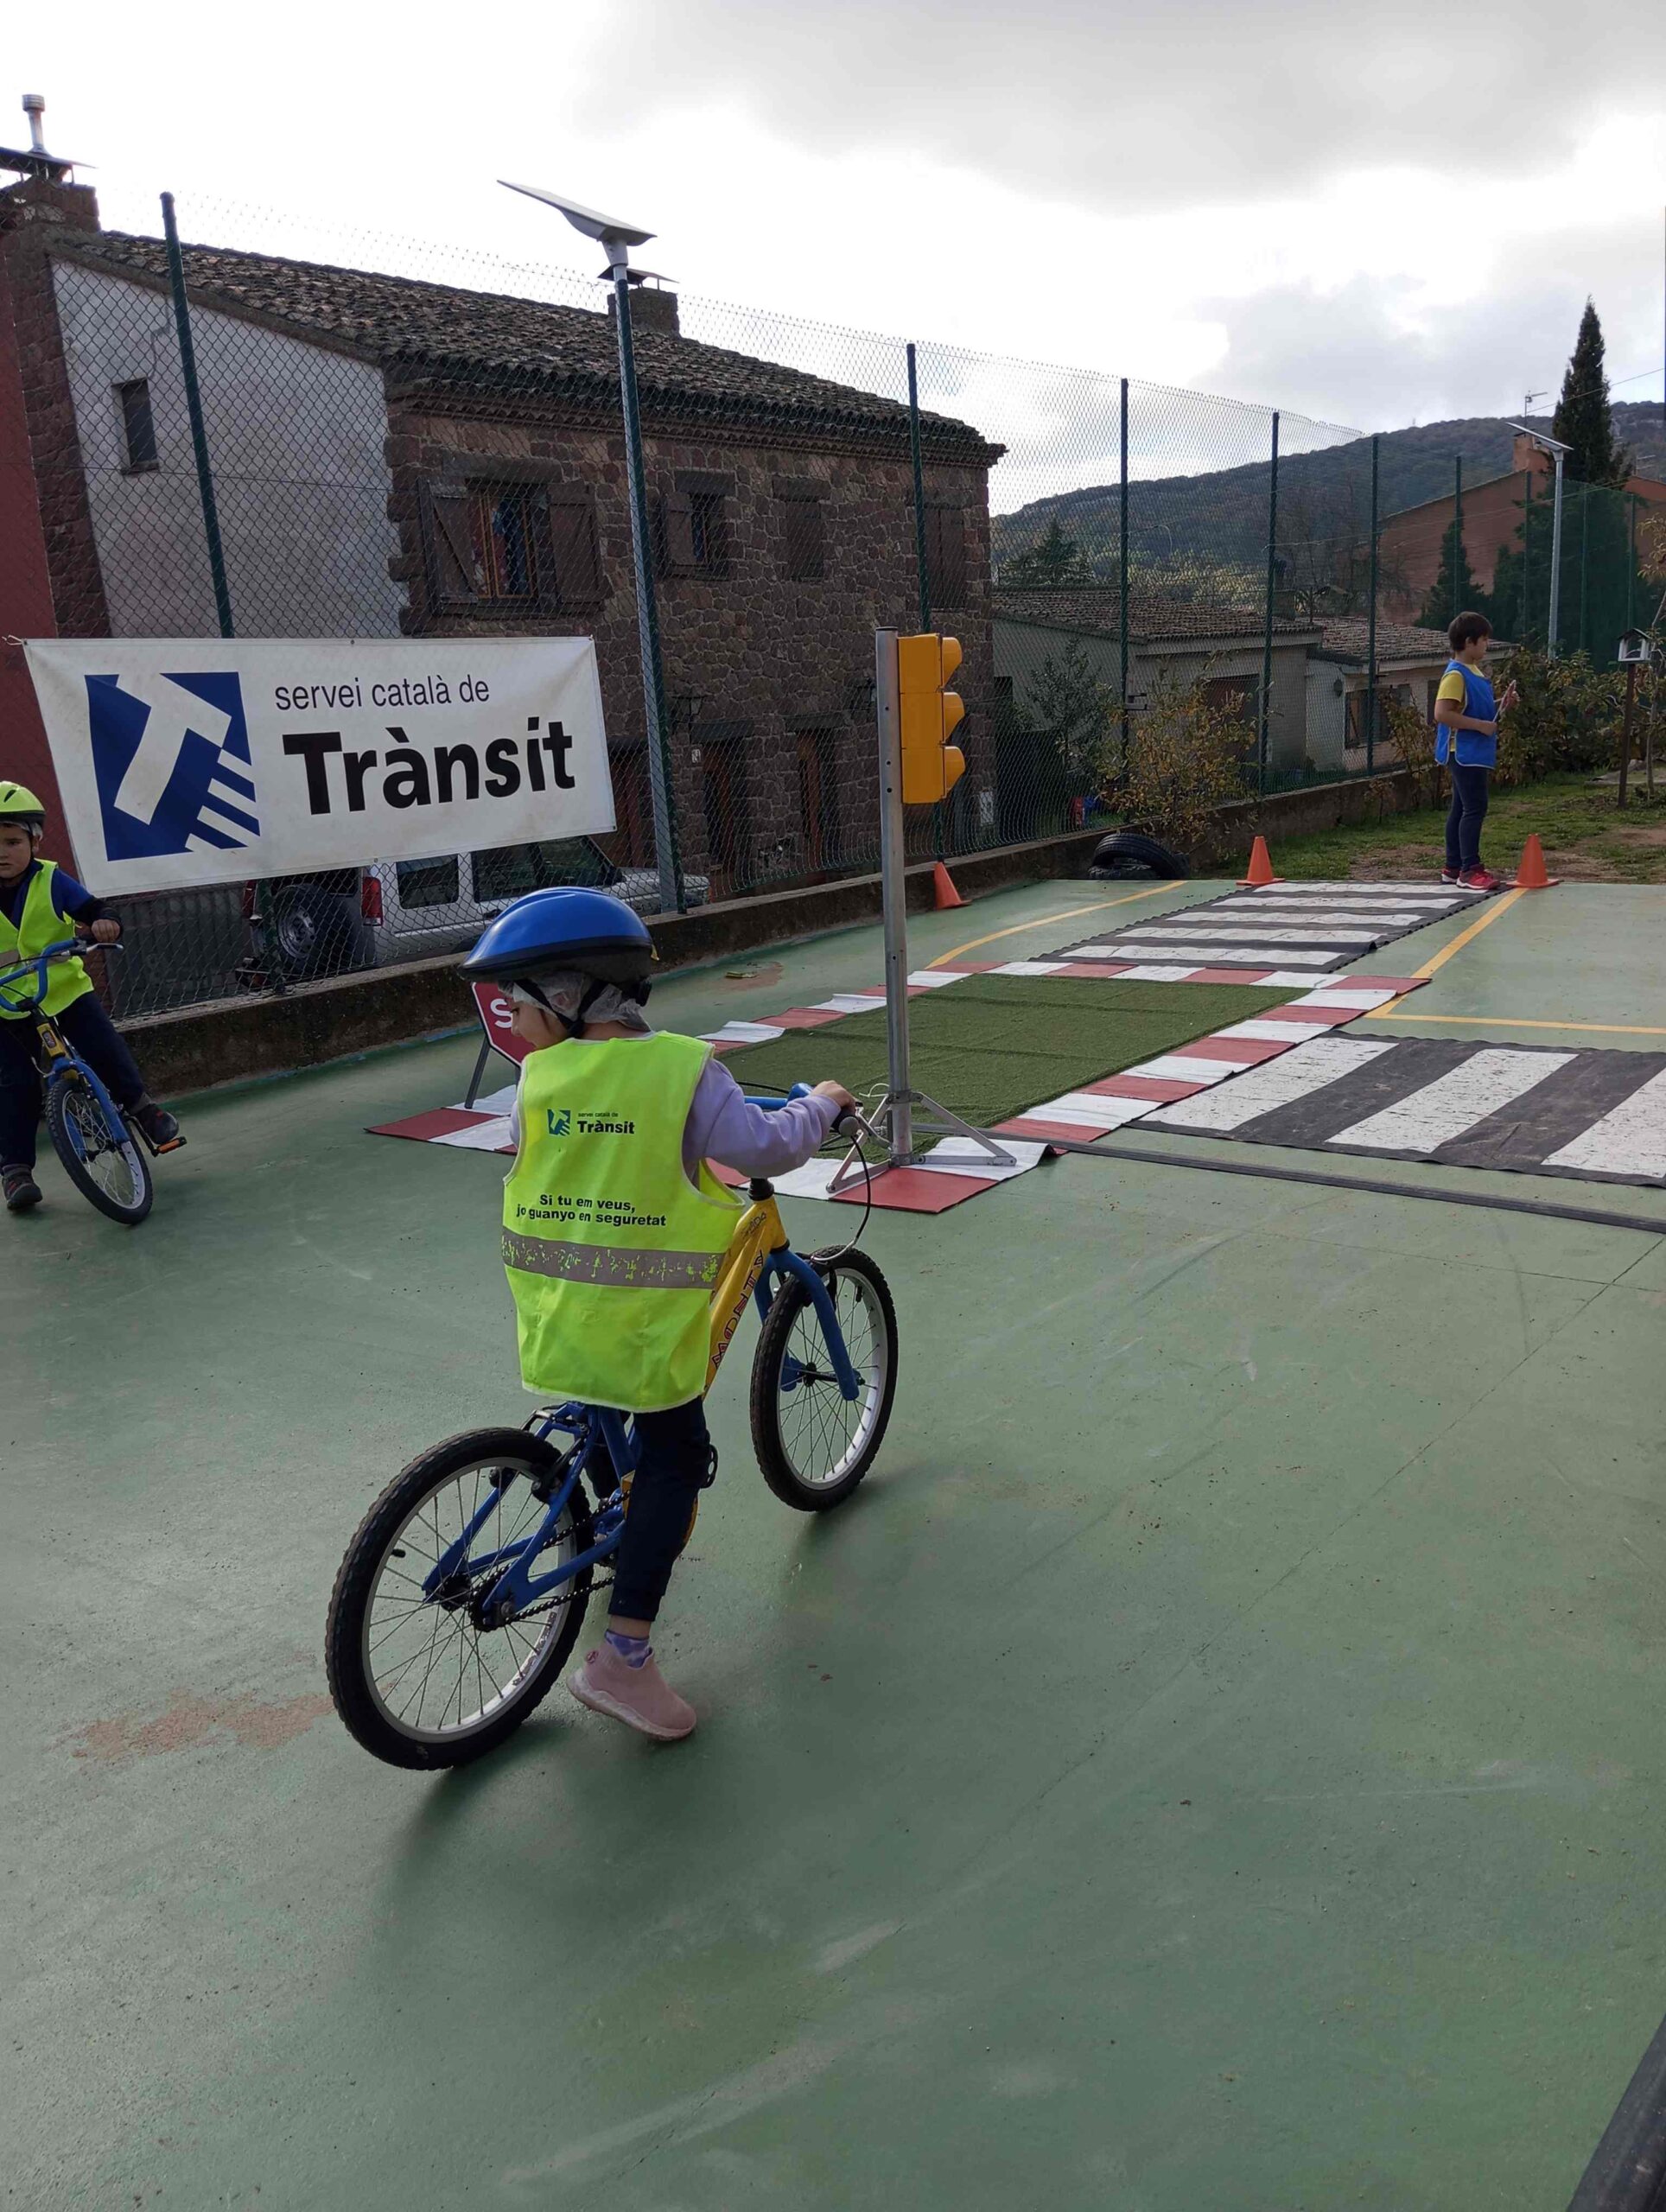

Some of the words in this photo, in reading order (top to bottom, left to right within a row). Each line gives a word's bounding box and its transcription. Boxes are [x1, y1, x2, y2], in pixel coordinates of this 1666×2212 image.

[275, 677, 362, 710] servei
[372, 675, 452, 707] català
[459, 674, 490, 702] de
[282, 716, 575, 816] Trànsit
[577, 1120, 635, 1134] Trànsit
[540, 1194, 553, 1205] Si
[557, 1195, 572, 1205] tu
[576, 1198, 592, 1208] em
[597, 1199, 635, 1213] veus,
[517, 1204, 526, 1217] jo
[529, 1209, 575, 1222] guanyo
[579, 1211, 591, 1222] en
[595, 1213, 666, 1226] seguretat
